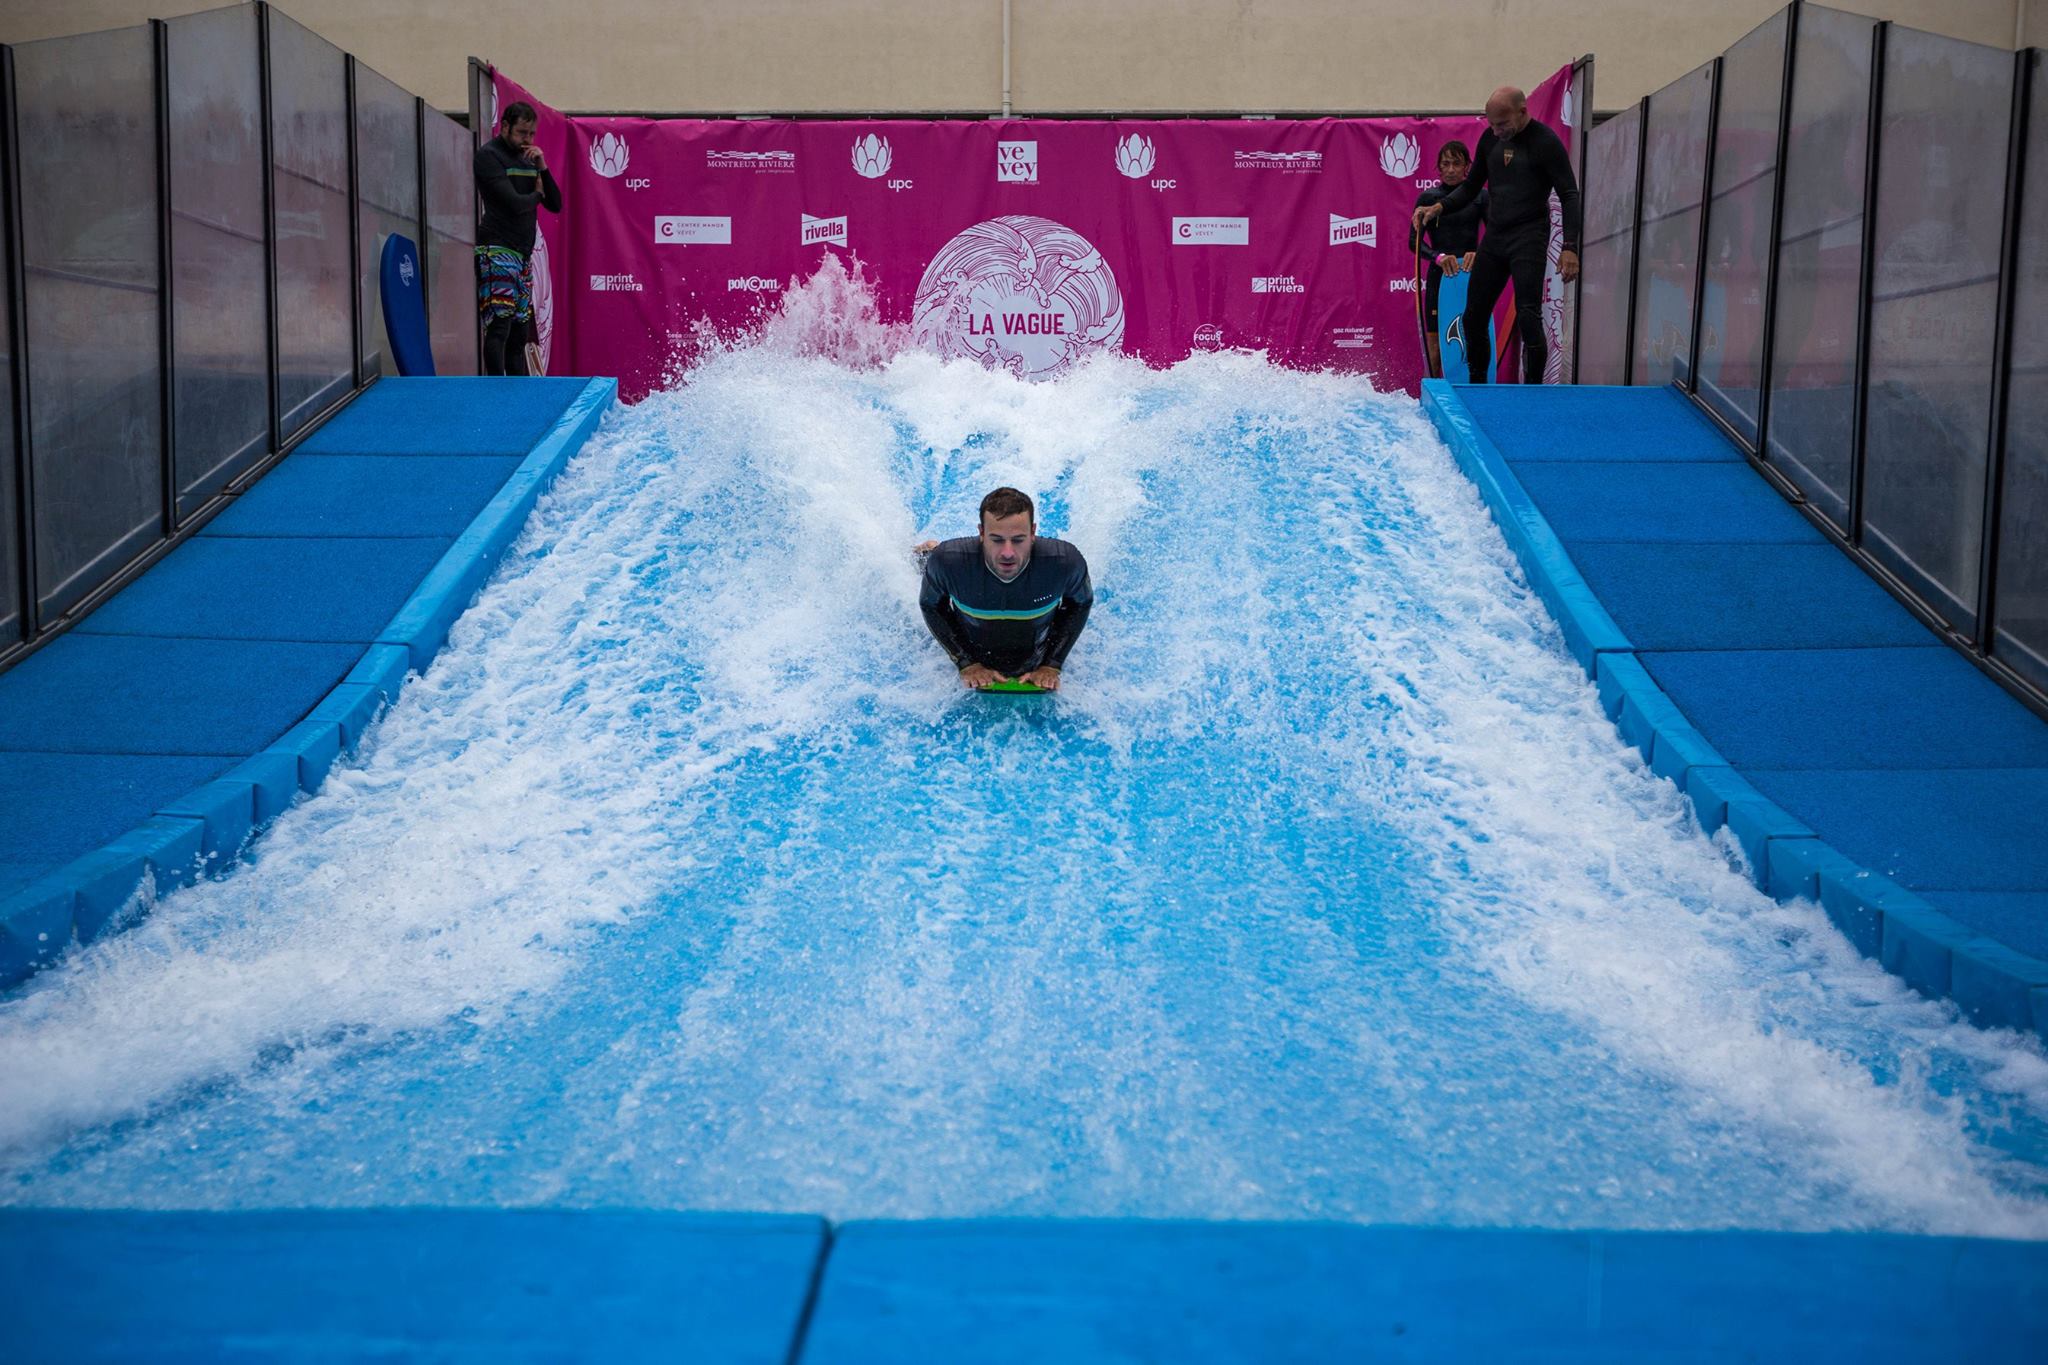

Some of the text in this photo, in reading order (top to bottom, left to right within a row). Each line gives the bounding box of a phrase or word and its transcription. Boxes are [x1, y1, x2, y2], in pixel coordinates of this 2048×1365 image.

[998, 146, 1025, 160] ve
[707, 160, 795, 168] MONTREUX RIVIERA
[1234, 160, 1322, 168] MONTREUX RIVIERA
[998, 162, 1037, 181] vey
[625, 178, 650, 192] upc
[888, 179, 913, 192] upc
[1151, 179, 1177, 192] upc
[1415, 179, 1441, 191] upc
[805, 222, 844, 241] rivella
[1333, 222, 1373, 241] rivella
[606, 272, 634, 285] print
[1267, 274, 1296, 286] print
[606, 283, 643, 291] riviera
[1267, 284, 1305, 292] riviera
[969, 313, 1065, 335] LA VAGUE
